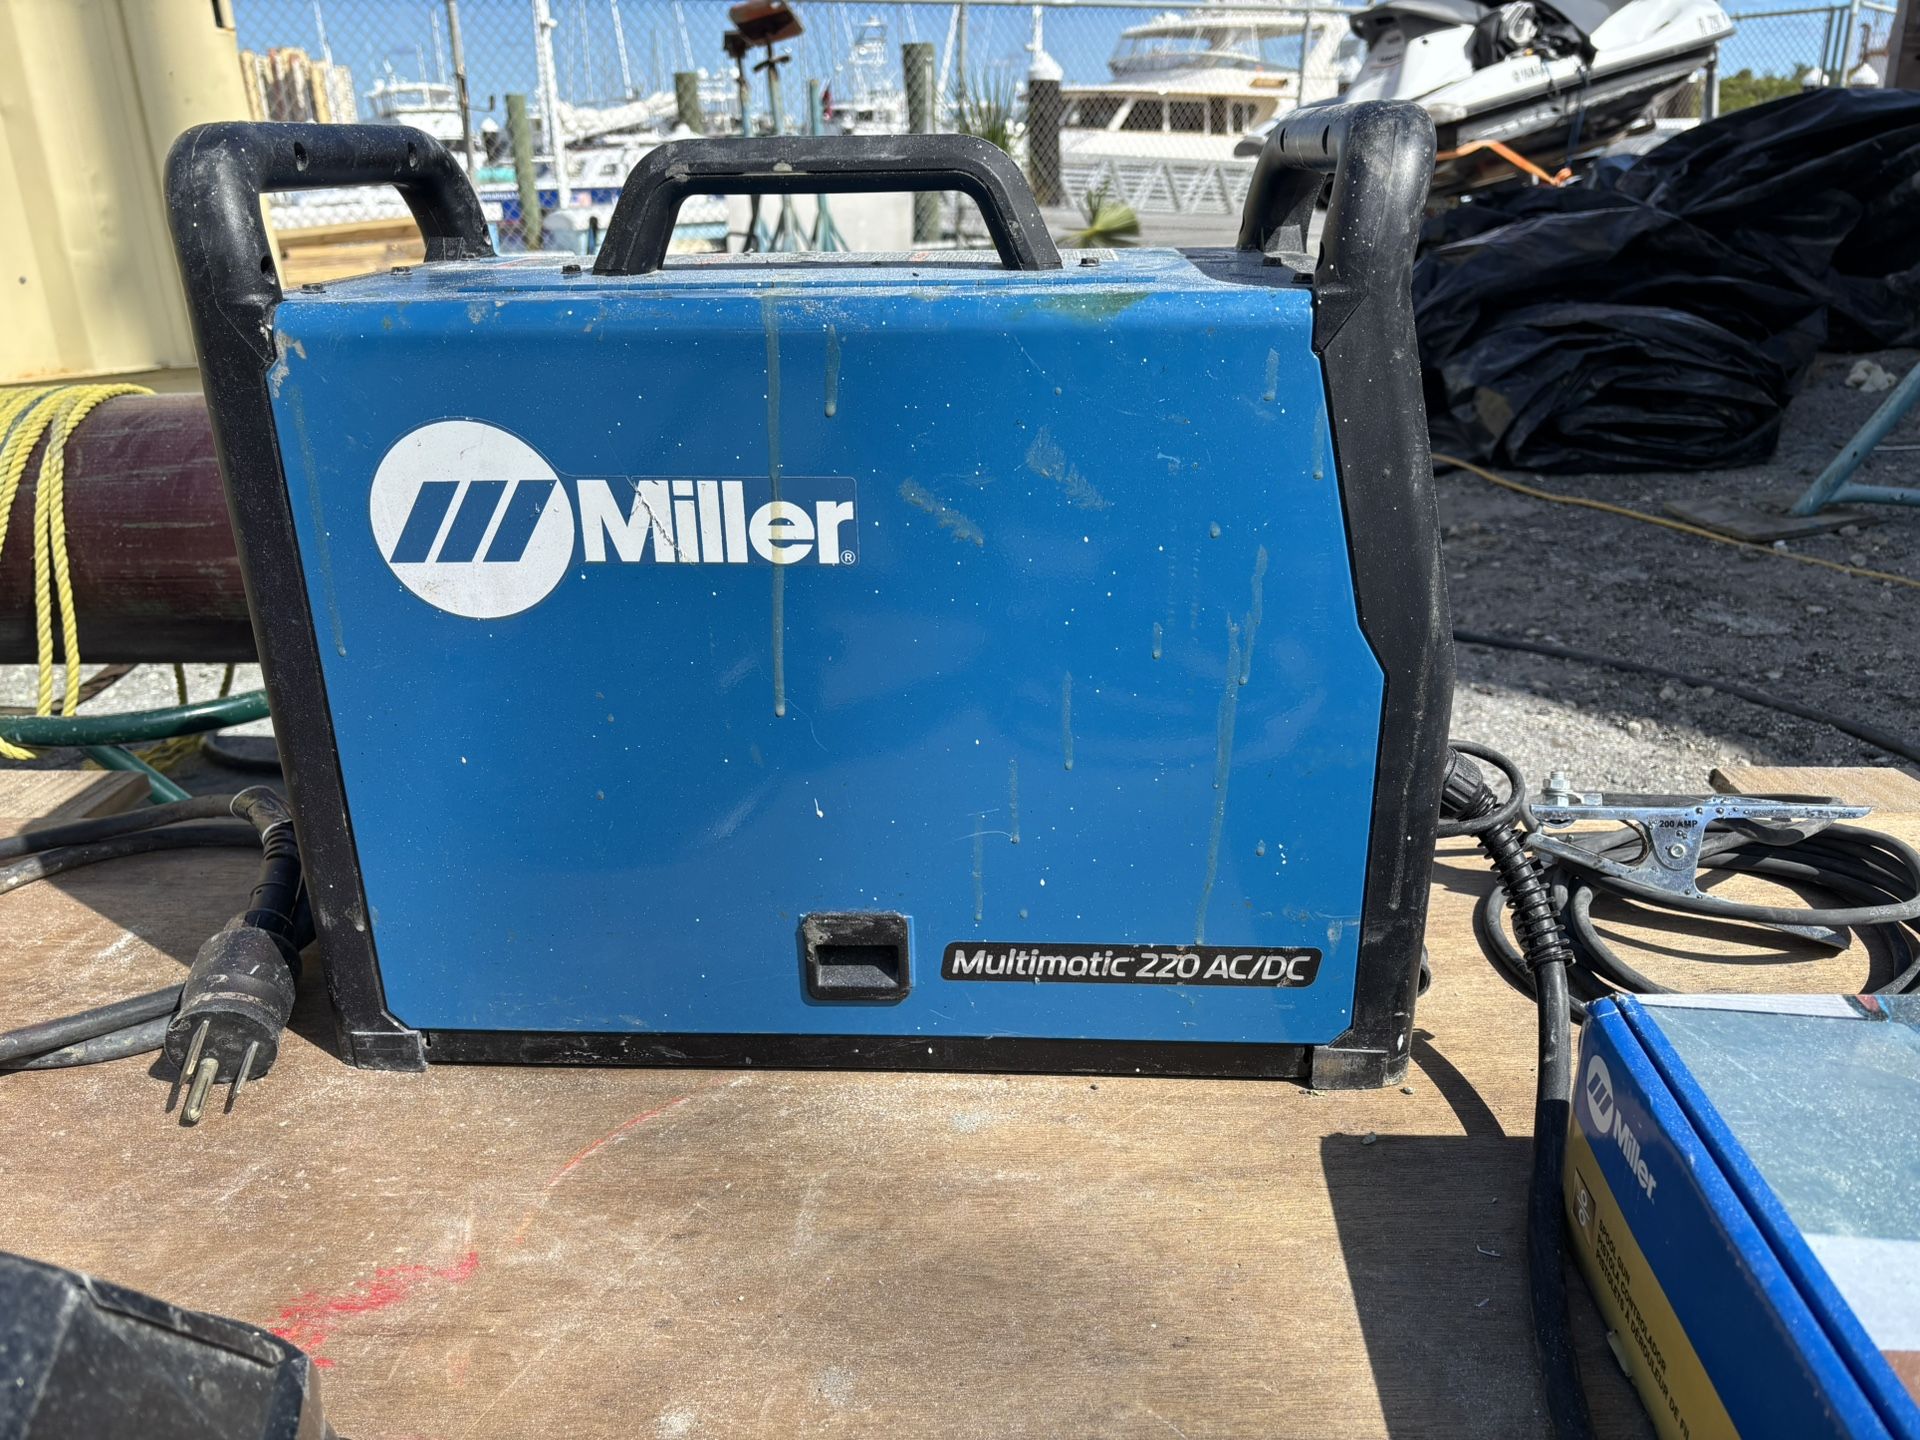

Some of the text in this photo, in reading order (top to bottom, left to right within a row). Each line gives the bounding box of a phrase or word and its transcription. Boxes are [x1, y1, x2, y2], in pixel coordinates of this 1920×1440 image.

[1659, 819, 1698, 829] 200 AMP
[951, 948, 1311, 982] Multimatic 220 AC/DC
[1612, 1108, 1657, 1200] Miller
[1599, 1219, 1630, 1286] SPOOL GUN
[1595, 1248, 1624, 1311] PISTOLETS
[1669, 1397, 1680, 1423] DE
[1597, 1233, 1666, 1375] PISTOLA CONTROLADOR
